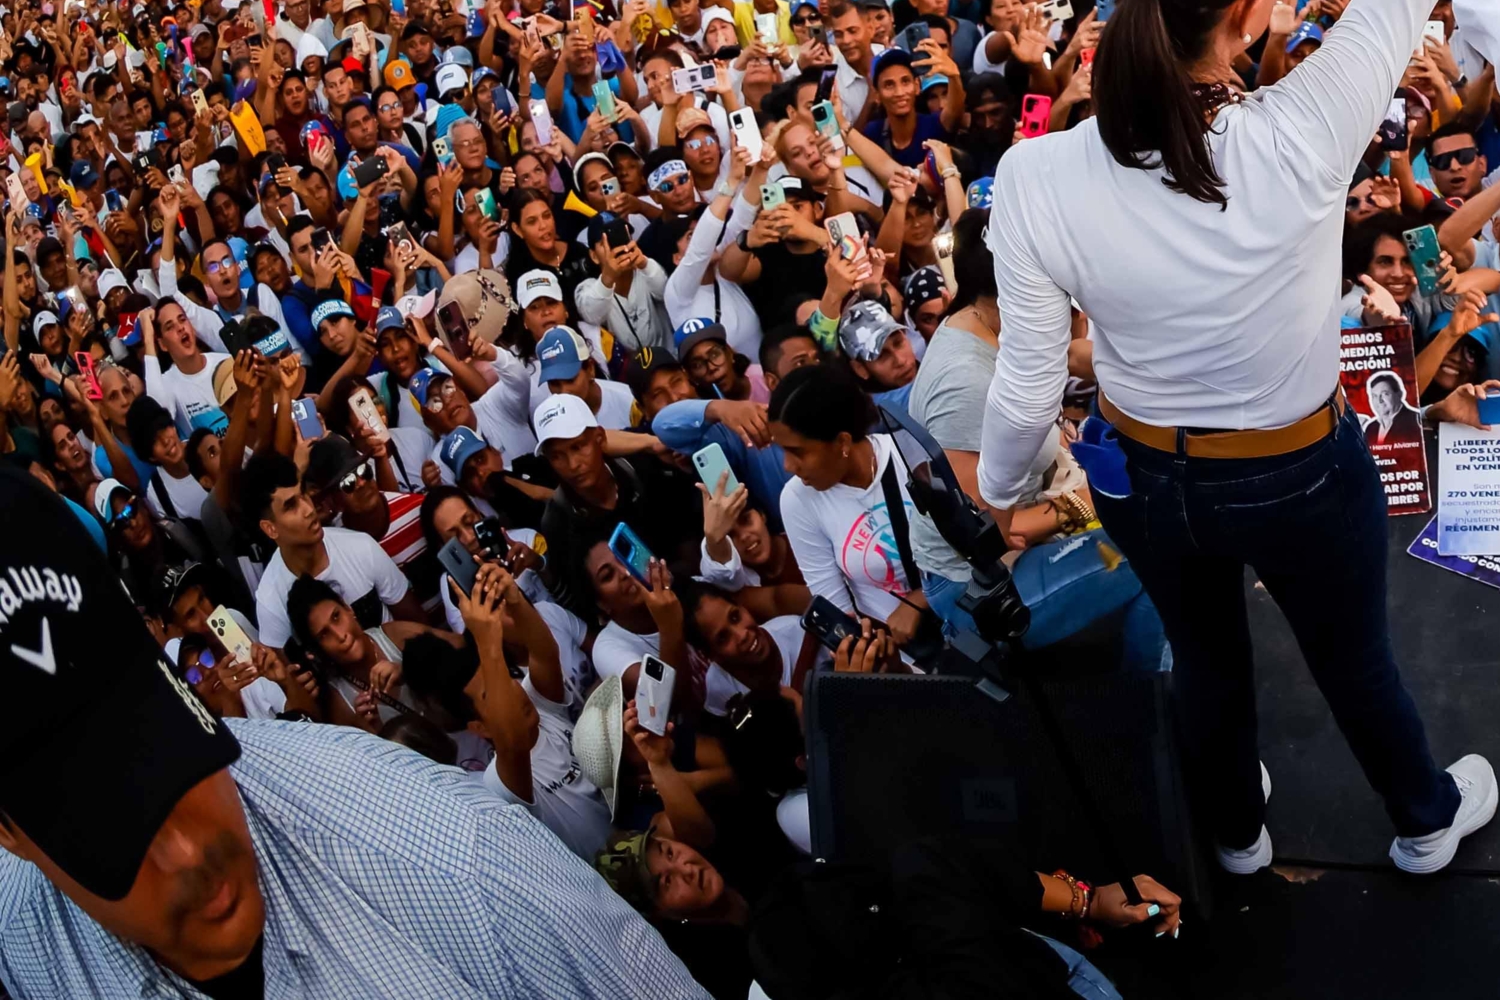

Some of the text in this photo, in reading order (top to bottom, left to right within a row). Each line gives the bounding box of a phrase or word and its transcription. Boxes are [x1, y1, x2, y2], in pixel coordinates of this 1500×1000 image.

[1340, 332, 1383, 344] GIMOS
[1396, 470, 1419, 480] POR
[1400, 482, 1424, 492] POR
[1388, 494, 1420, 505] IBRES
[853, 511, 878, 551] NEW
[1445, 523, 1500, 532] RÉGIMEN
[0, 565, 83, 616] away
